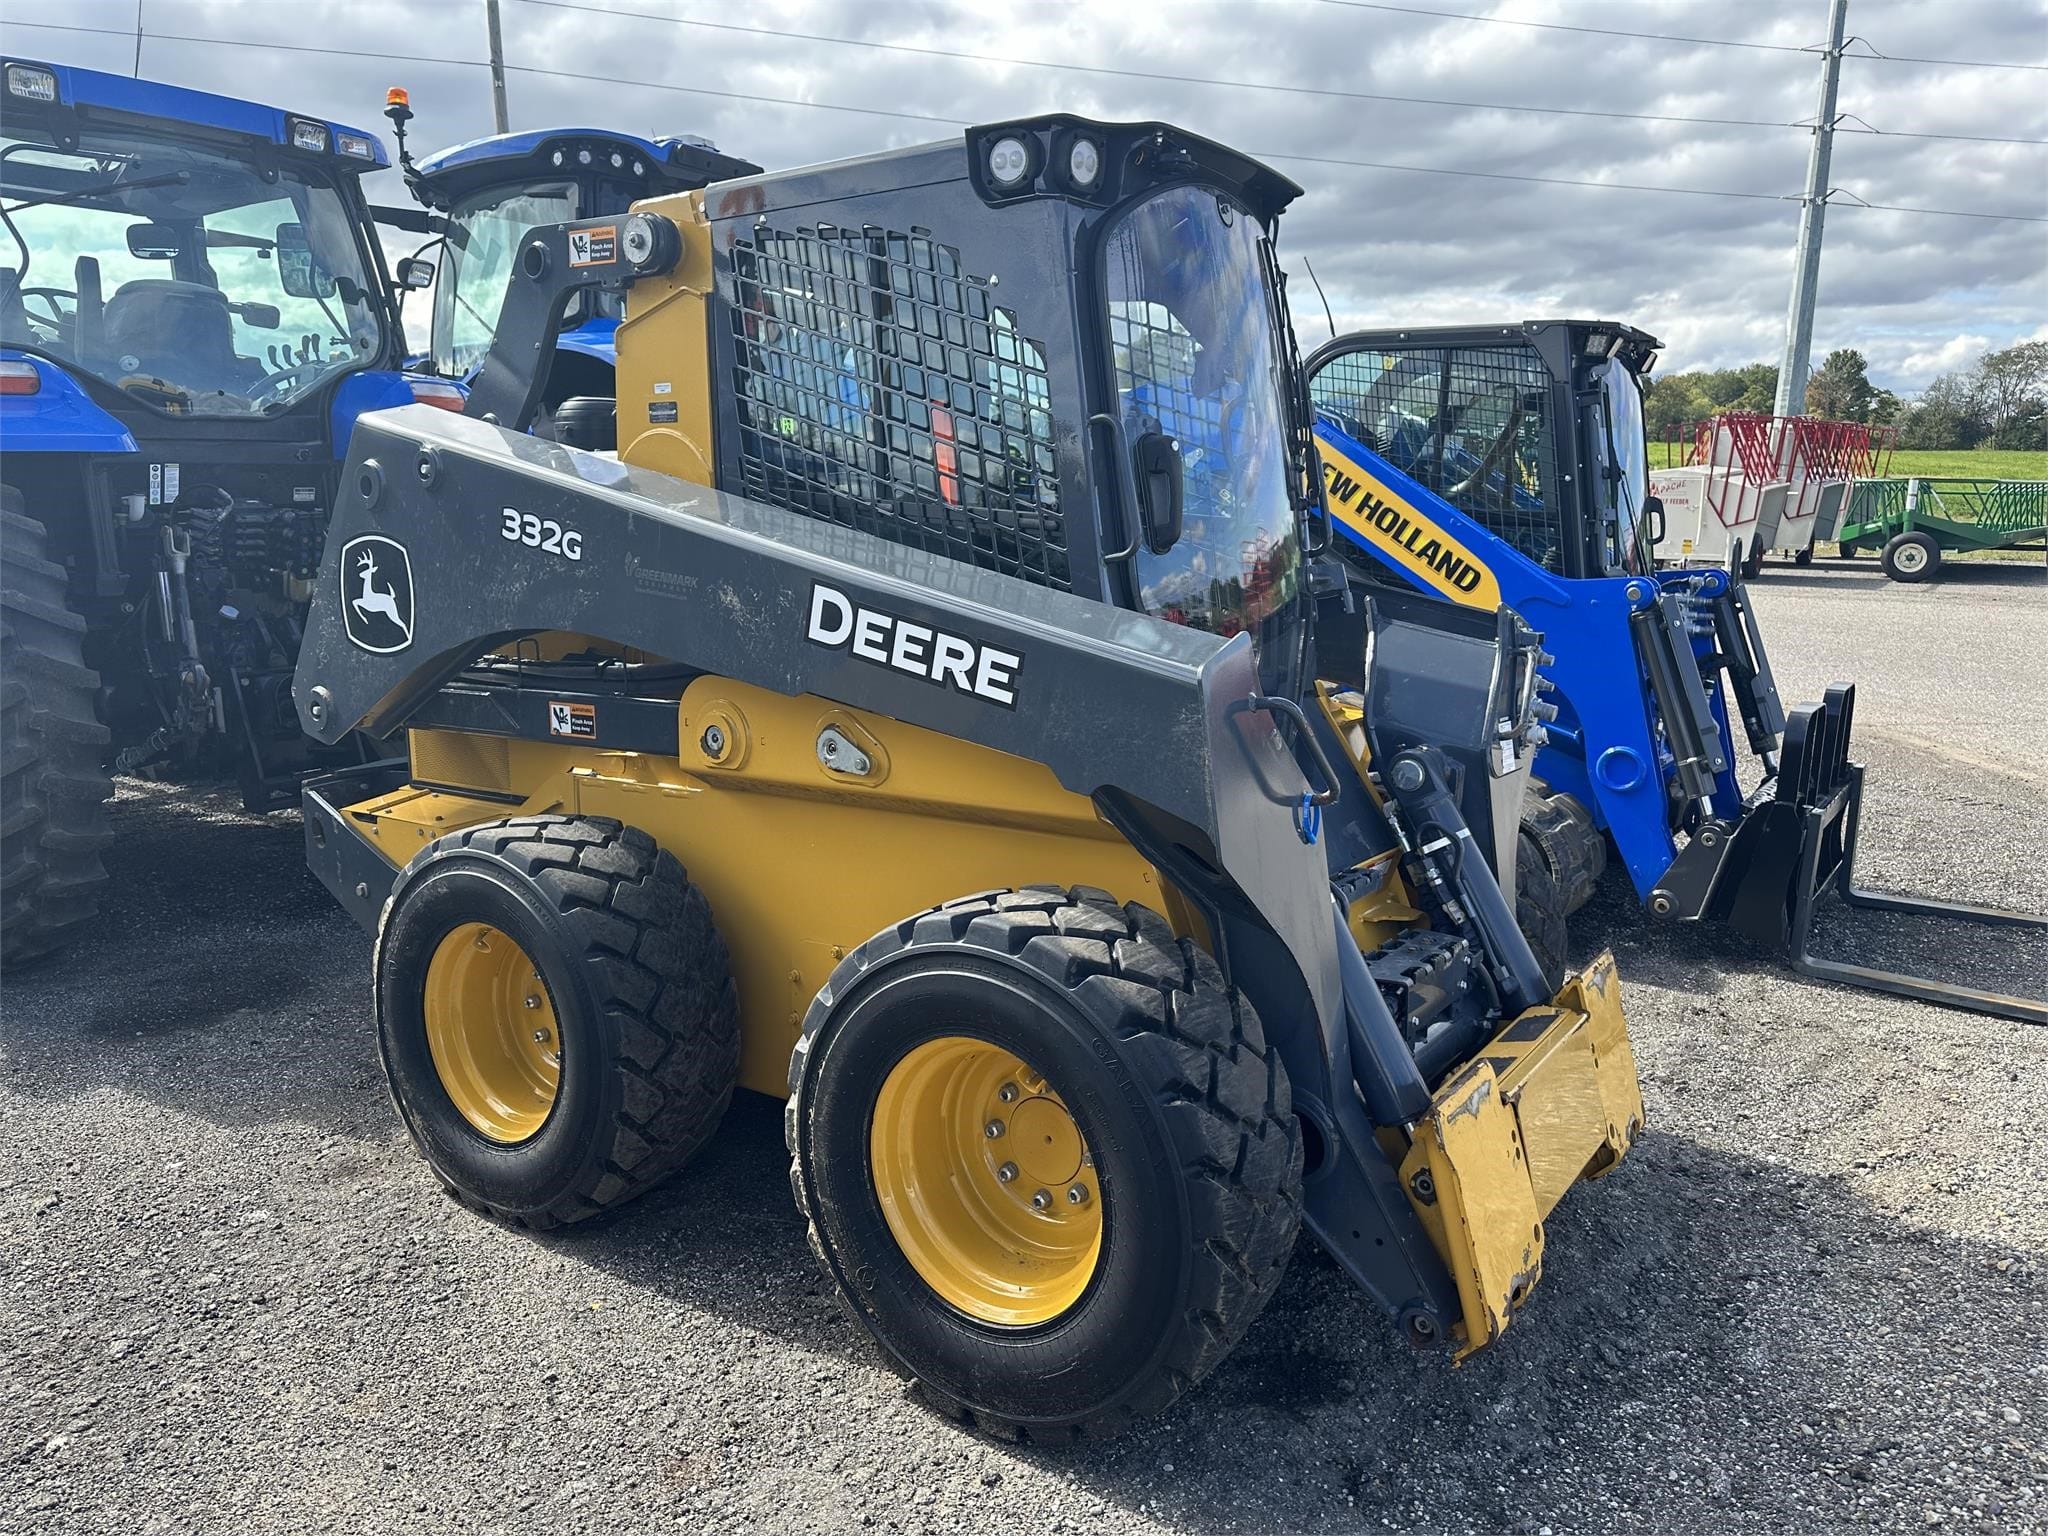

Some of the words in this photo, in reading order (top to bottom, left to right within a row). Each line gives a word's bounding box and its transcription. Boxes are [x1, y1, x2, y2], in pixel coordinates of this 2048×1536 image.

[501, 508, 582, 560] 332G
[1355, 490, 1482, 592] HOLLAND
[634, 567, 699, 589] GREENMARK
[808, 583, 1020, 705] DEERE
